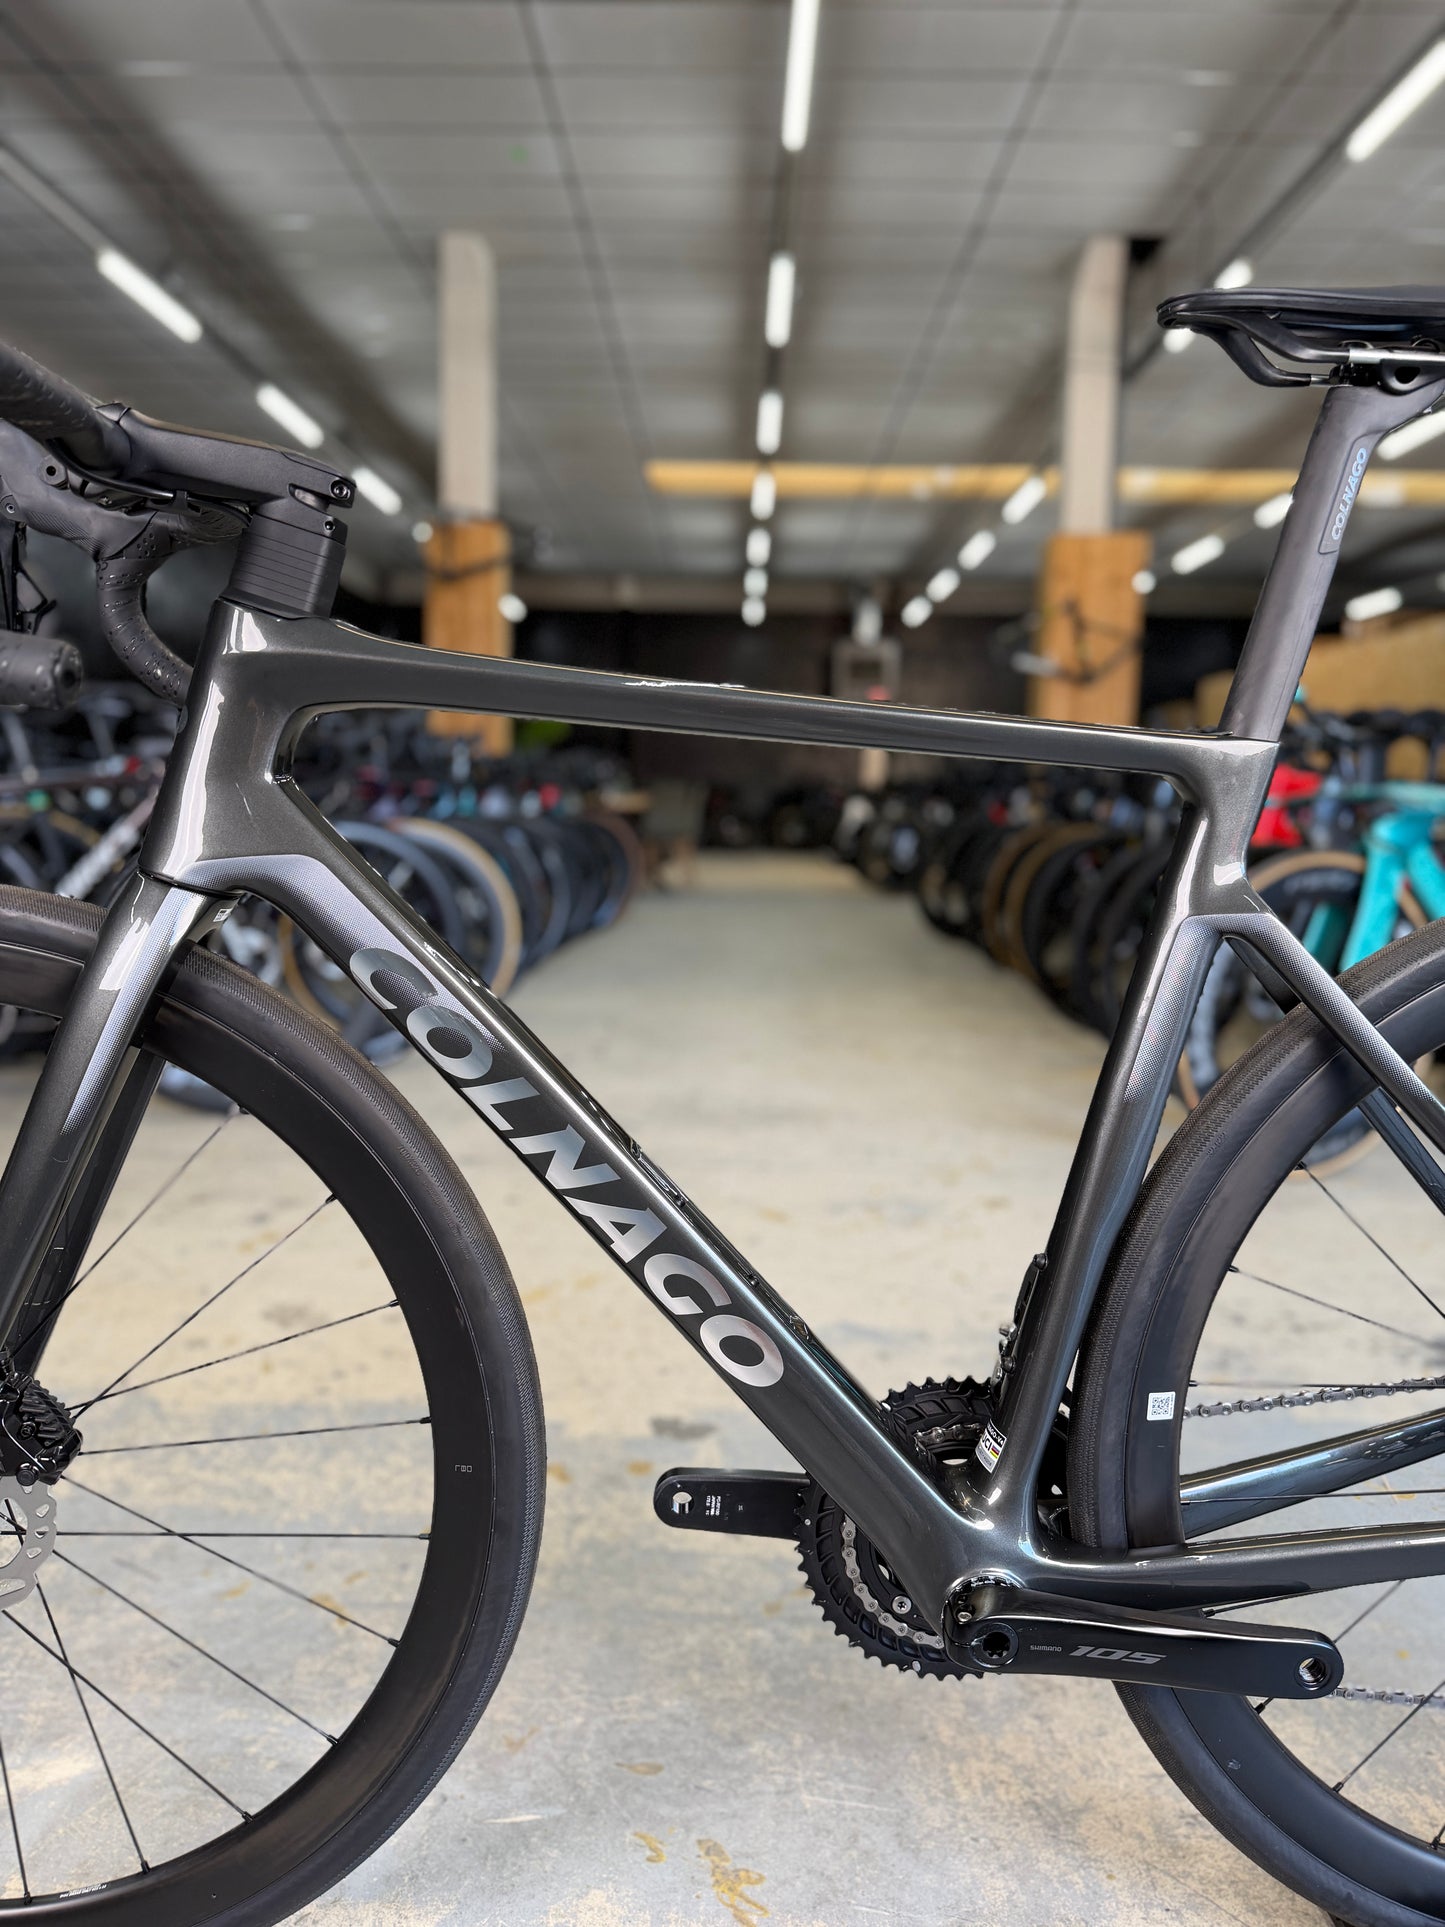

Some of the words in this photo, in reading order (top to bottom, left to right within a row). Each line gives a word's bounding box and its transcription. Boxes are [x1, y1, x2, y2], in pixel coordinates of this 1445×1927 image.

[1331, 447, 1367, 540] COLNAGO
[349, 947, 784, 1387] COLNAGO
[1069, 1645, 1167, 1665] 105
